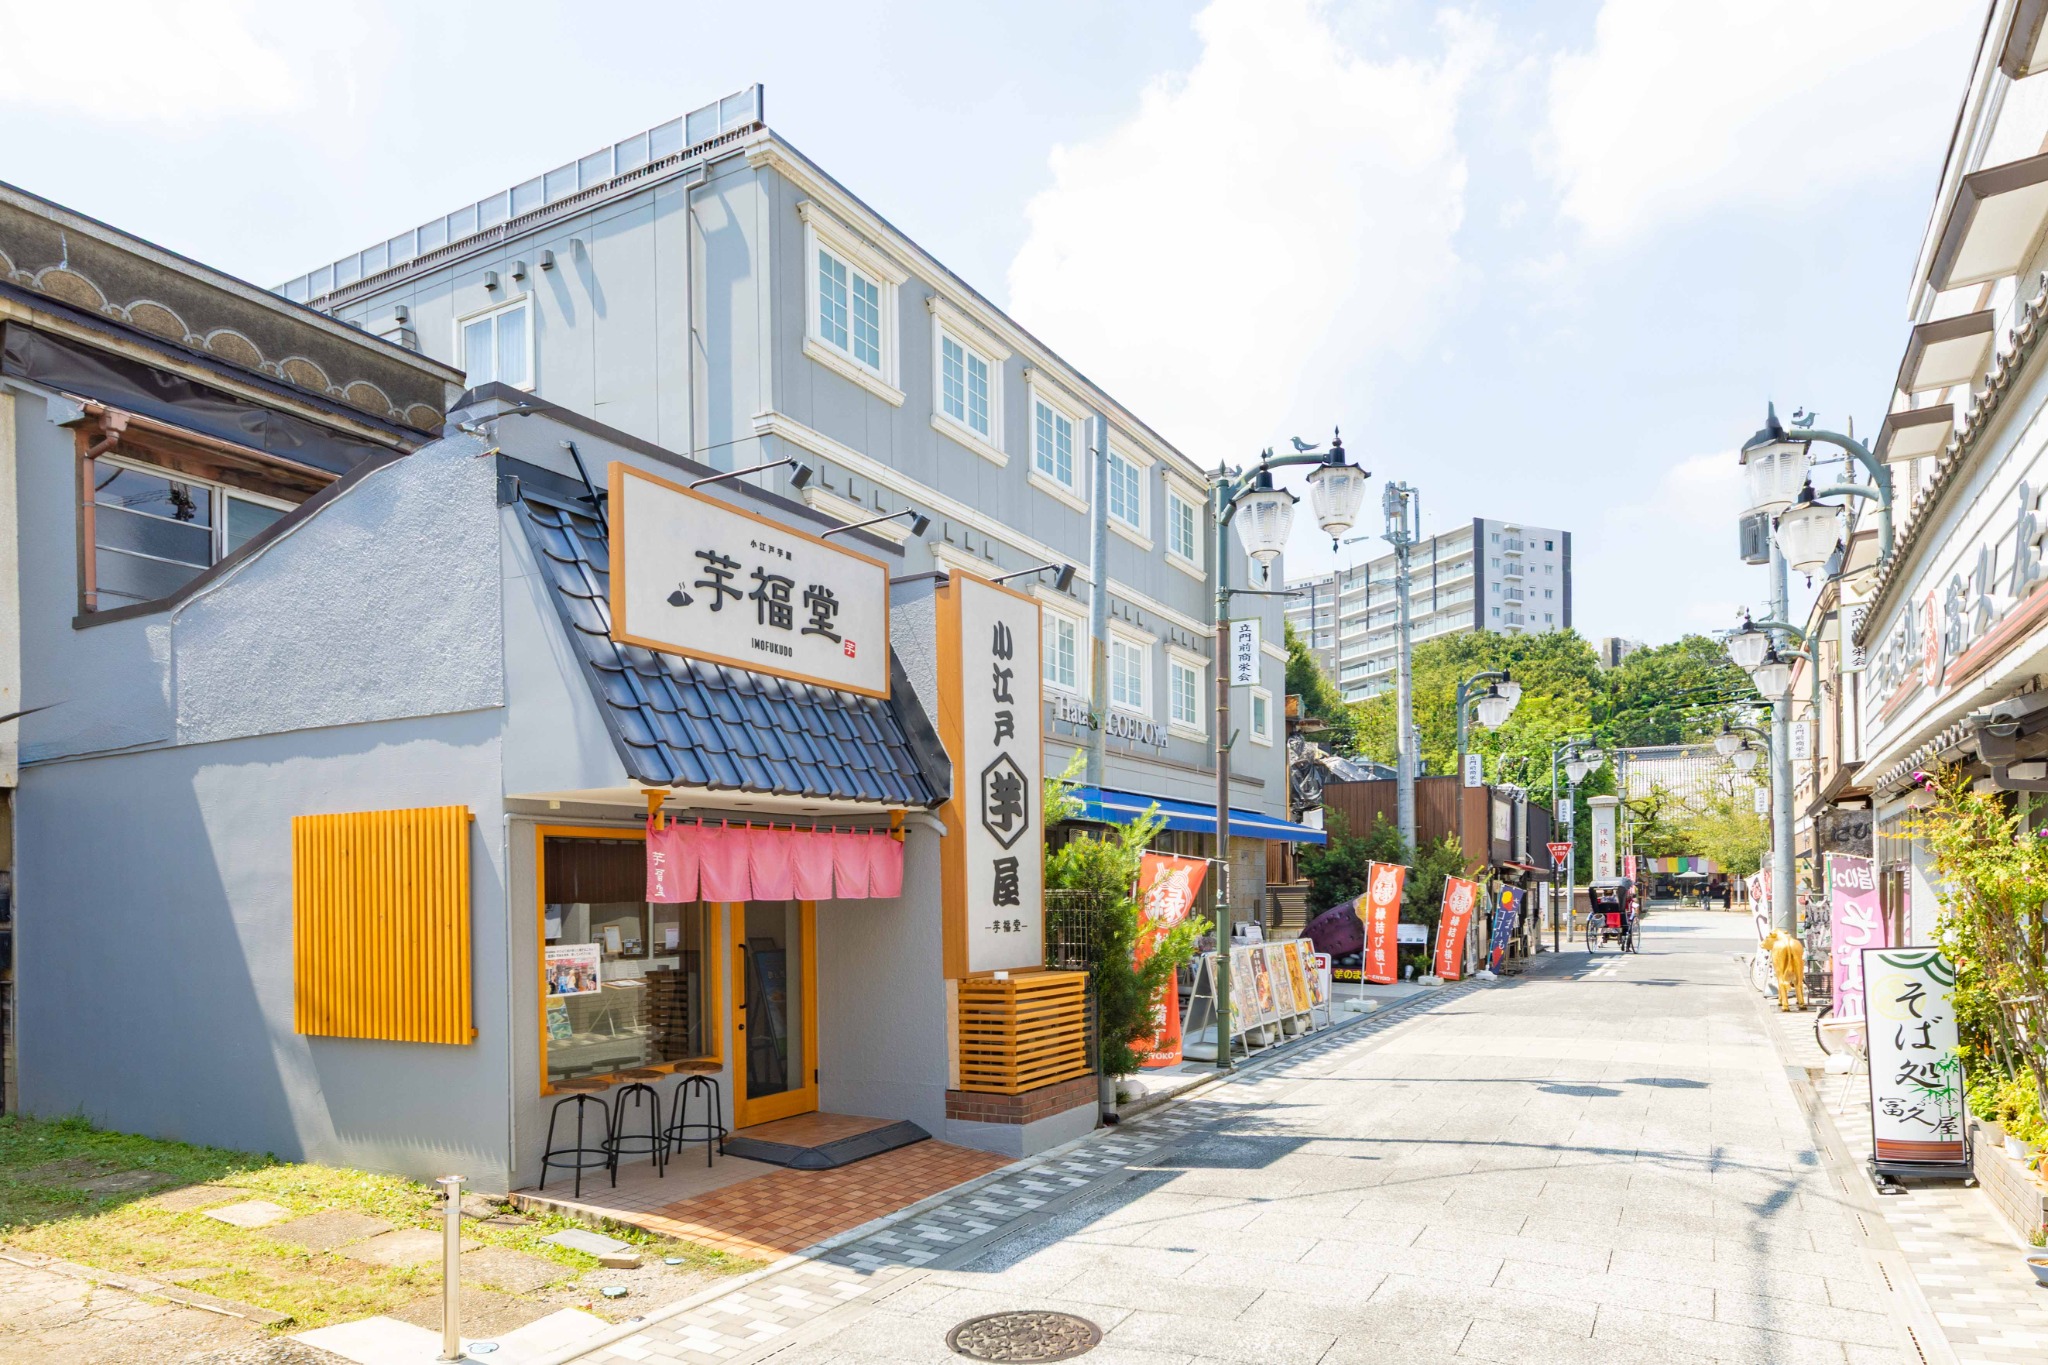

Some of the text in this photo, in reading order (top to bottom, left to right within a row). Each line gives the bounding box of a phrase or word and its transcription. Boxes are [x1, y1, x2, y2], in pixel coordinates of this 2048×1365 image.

[694, 550, 842, 644] 芋福堂
[751, 637, 793, 657] IMOFUKUDO
[1238, 623, 1252, 682] 立門前商栄会
[1108, 713, 1169, 748] COEDOYA
[989, 620, 1023, 907] 小江戸芋屋
[991, 920, 1022, 933] 芋福堂
[1150, 888, 1186, 920] 縁
[1374, 907, 1386, 974] 縁結び横丁
[1444, 916, 1460, 971] 縁結び横丁
[1895, 982, 1944, 1088] そば処
